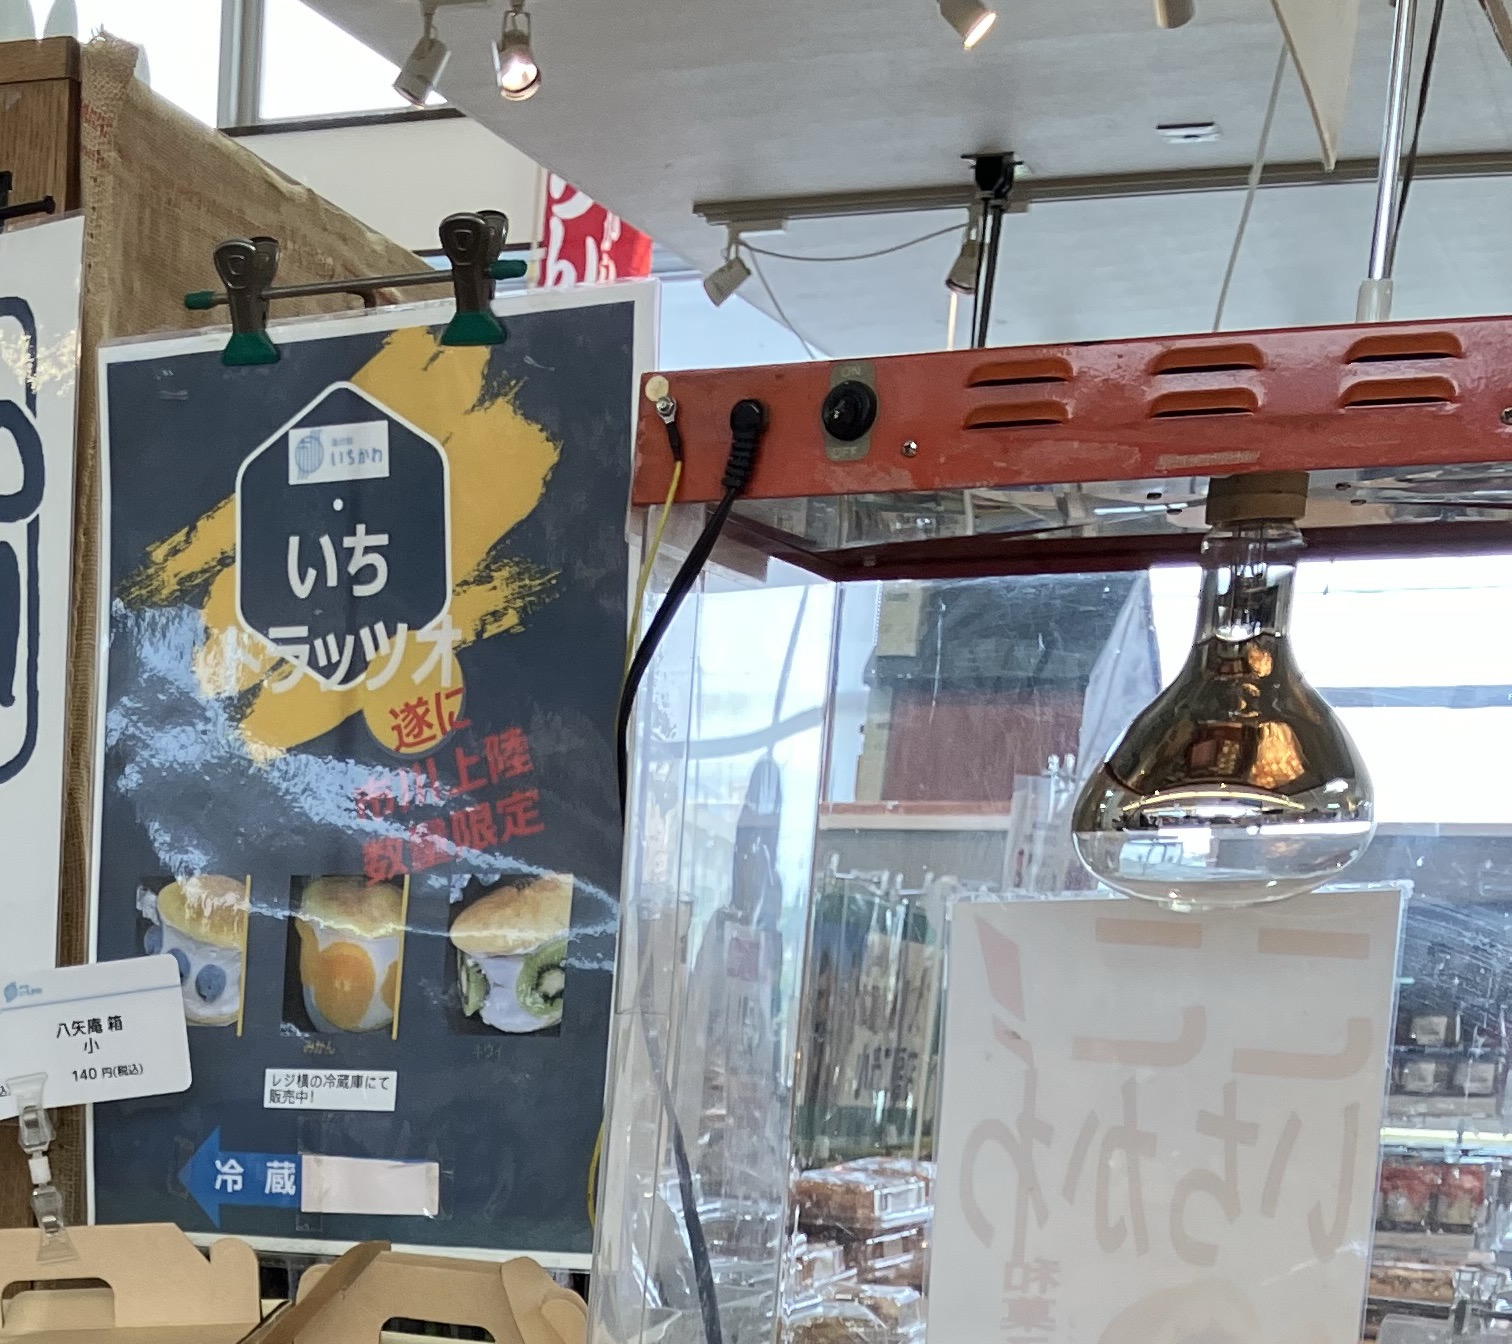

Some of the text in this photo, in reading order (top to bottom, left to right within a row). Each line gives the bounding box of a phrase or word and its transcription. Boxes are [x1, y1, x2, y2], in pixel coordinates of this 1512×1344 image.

[288, 524, 390, 599] いち
[389, 688, 472, 753] 遂に
[107, 1015, 124, 1032] 箱
[83, 1037, 99, 1054] 小
[71, 1062, 144, 1082] 140 円(税込)
[271, 1073, 389, 1091] レジ横の冷蔵庫にて
